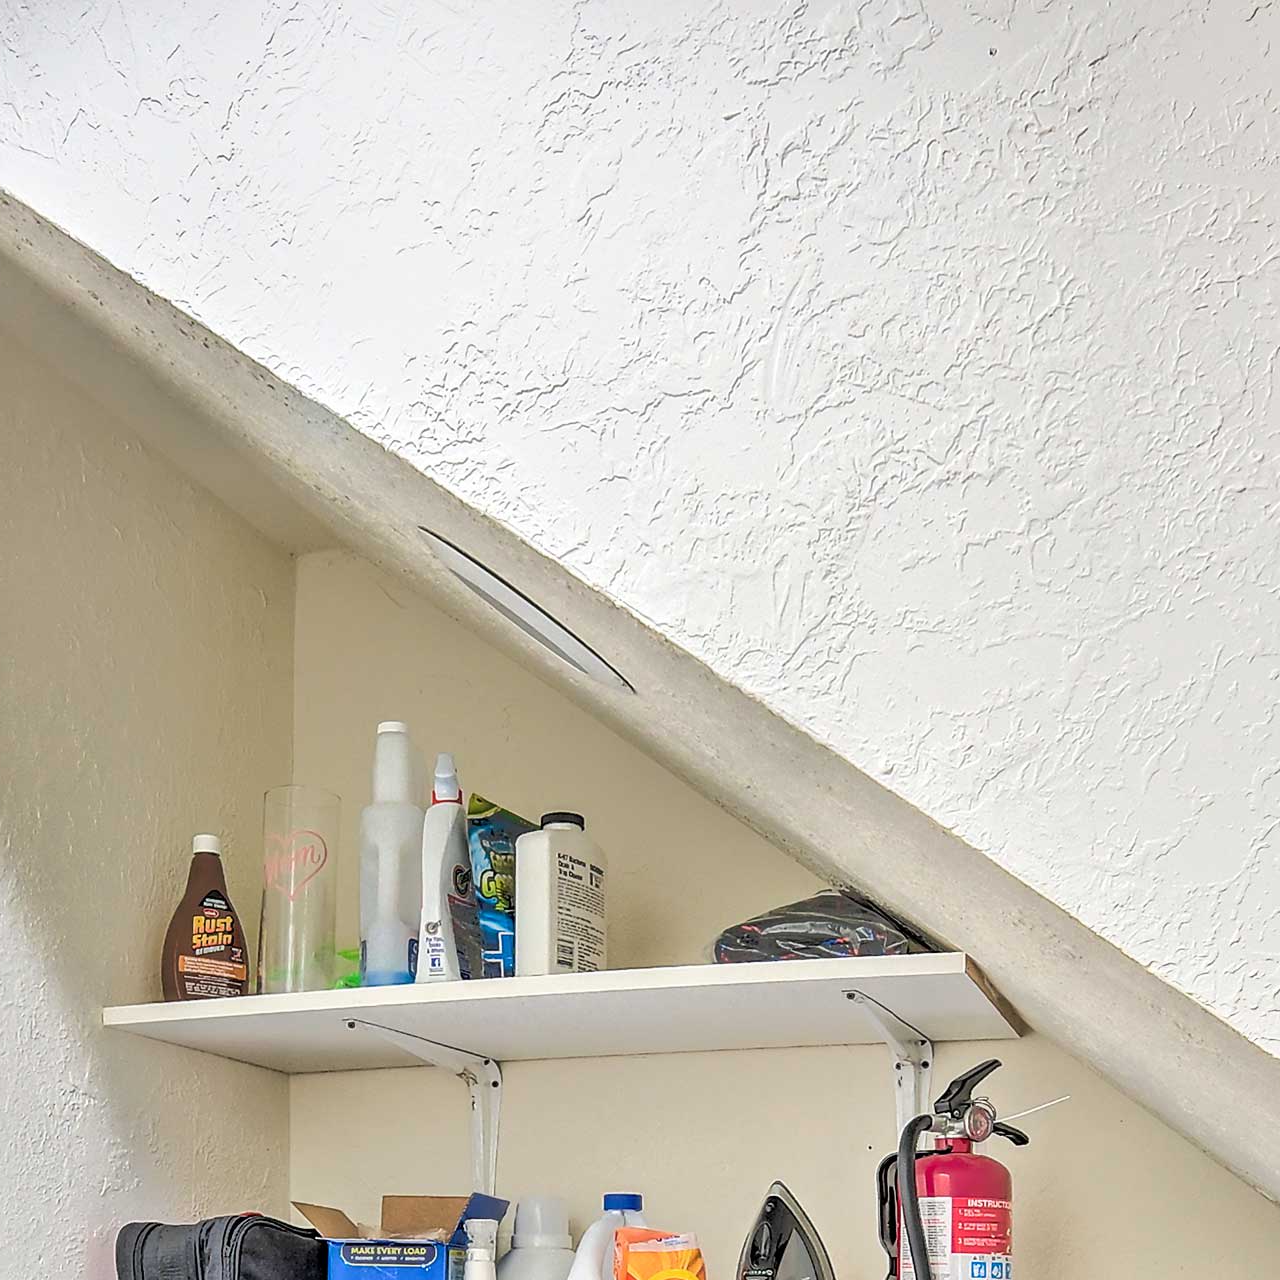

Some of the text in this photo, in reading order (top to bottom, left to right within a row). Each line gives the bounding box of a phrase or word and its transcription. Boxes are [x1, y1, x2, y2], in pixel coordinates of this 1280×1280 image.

[193, 915, 234, 934] Rust
[192, 933, 232, 950] Stain
[351, 1247, 426, 1255] MAKE EVERY LOAD
